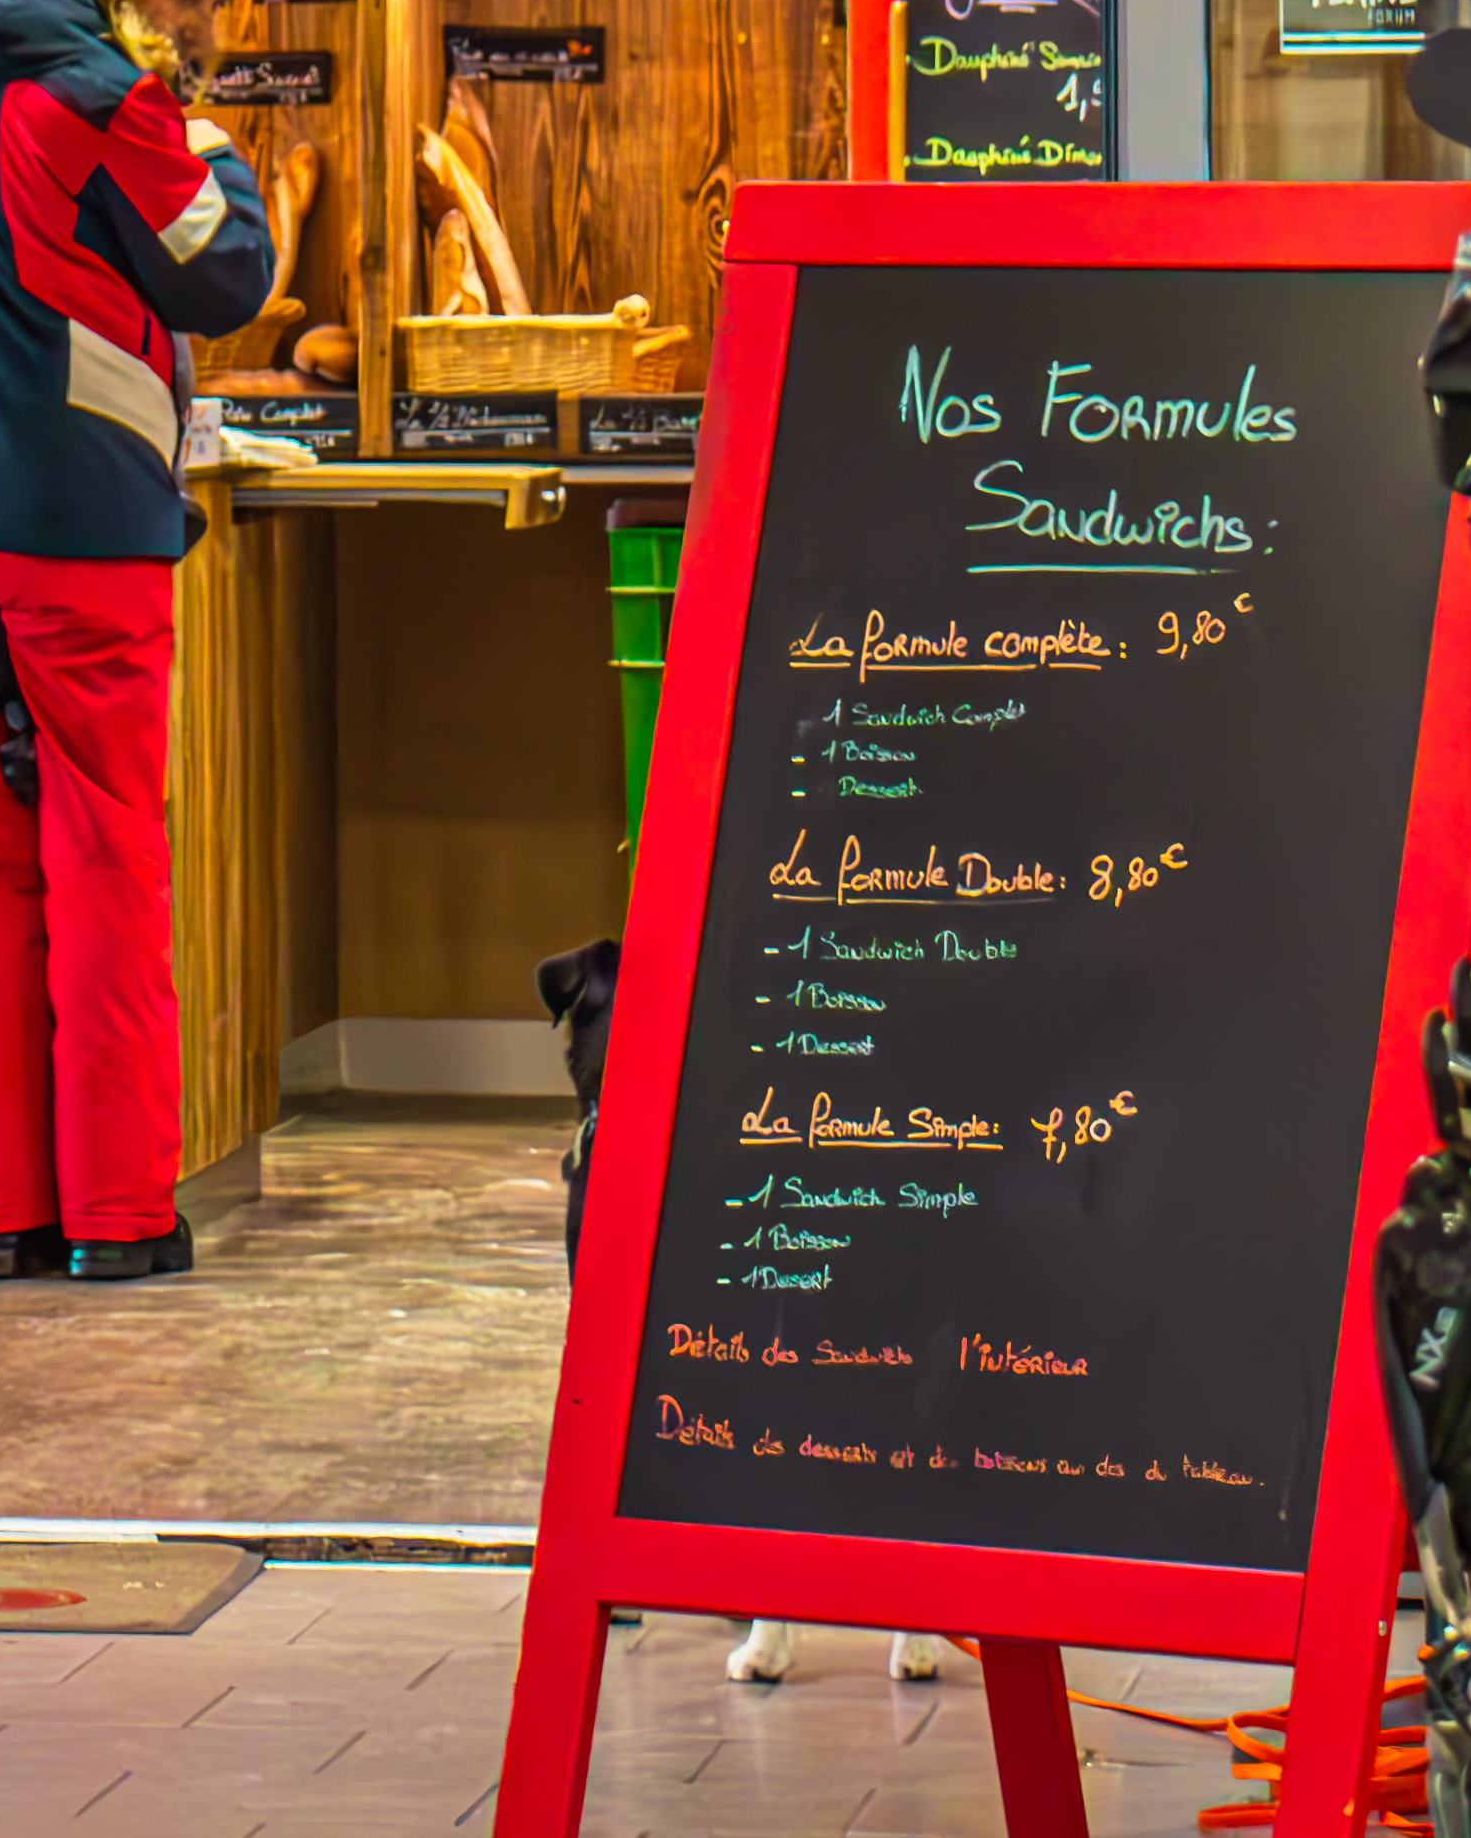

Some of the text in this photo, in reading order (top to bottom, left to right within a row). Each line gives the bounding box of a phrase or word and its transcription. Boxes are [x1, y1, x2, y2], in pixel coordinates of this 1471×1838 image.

[898, 345, 1002, 443] Nos
[790, 611, 854, 657] La
[822, 698, 842, 727] 1
[769, 829, 821, 887] La
[787, 925, 811, 960] 1
[819, 930, 925, 961] Sandwich
[742, 1087, 797, 1136] La
[748, 1174, 979, 1218] 1 Sandwich Simple
